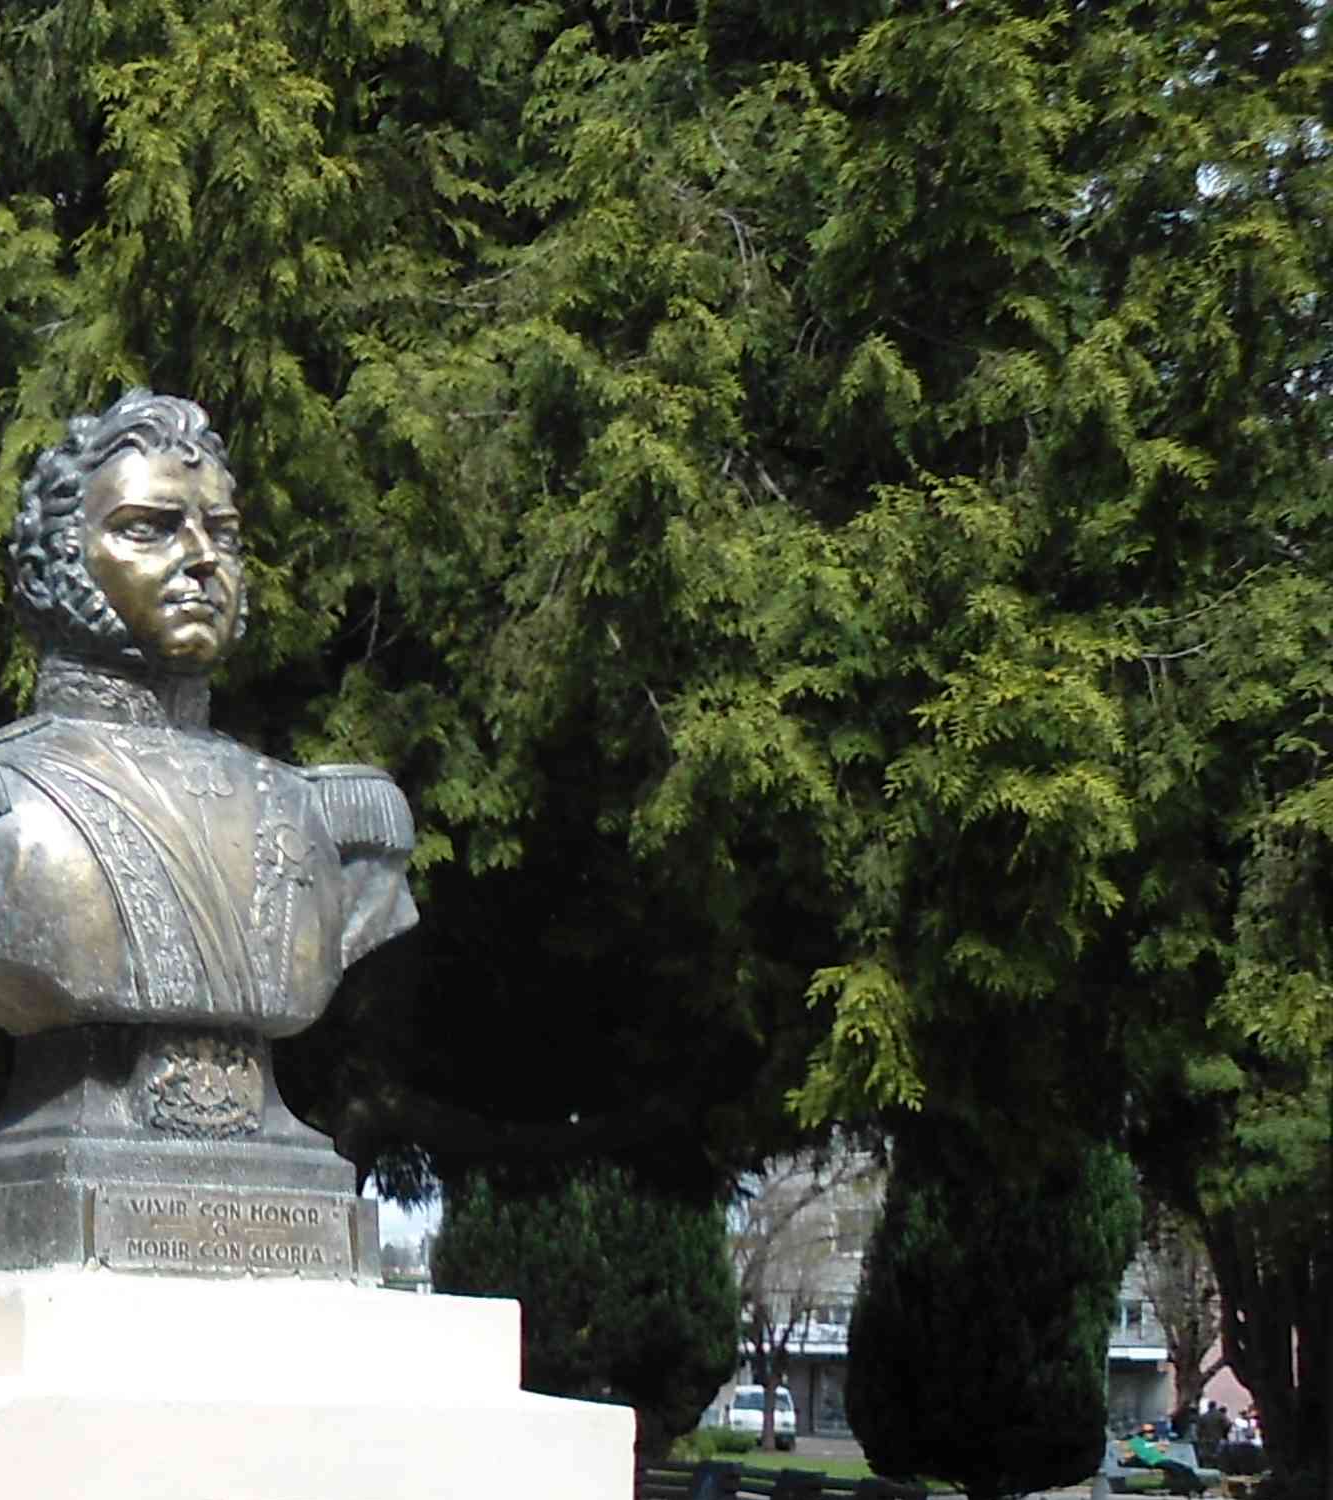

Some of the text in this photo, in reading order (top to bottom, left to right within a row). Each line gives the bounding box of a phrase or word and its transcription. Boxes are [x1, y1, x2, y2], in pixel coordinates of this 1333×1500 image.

[129, 1199, 320, 1226] VIVIR CON HONOR
[213, 1221, 228, 1238] O
[126, 1239, 325, 1267] MORIR CON GLORIA
